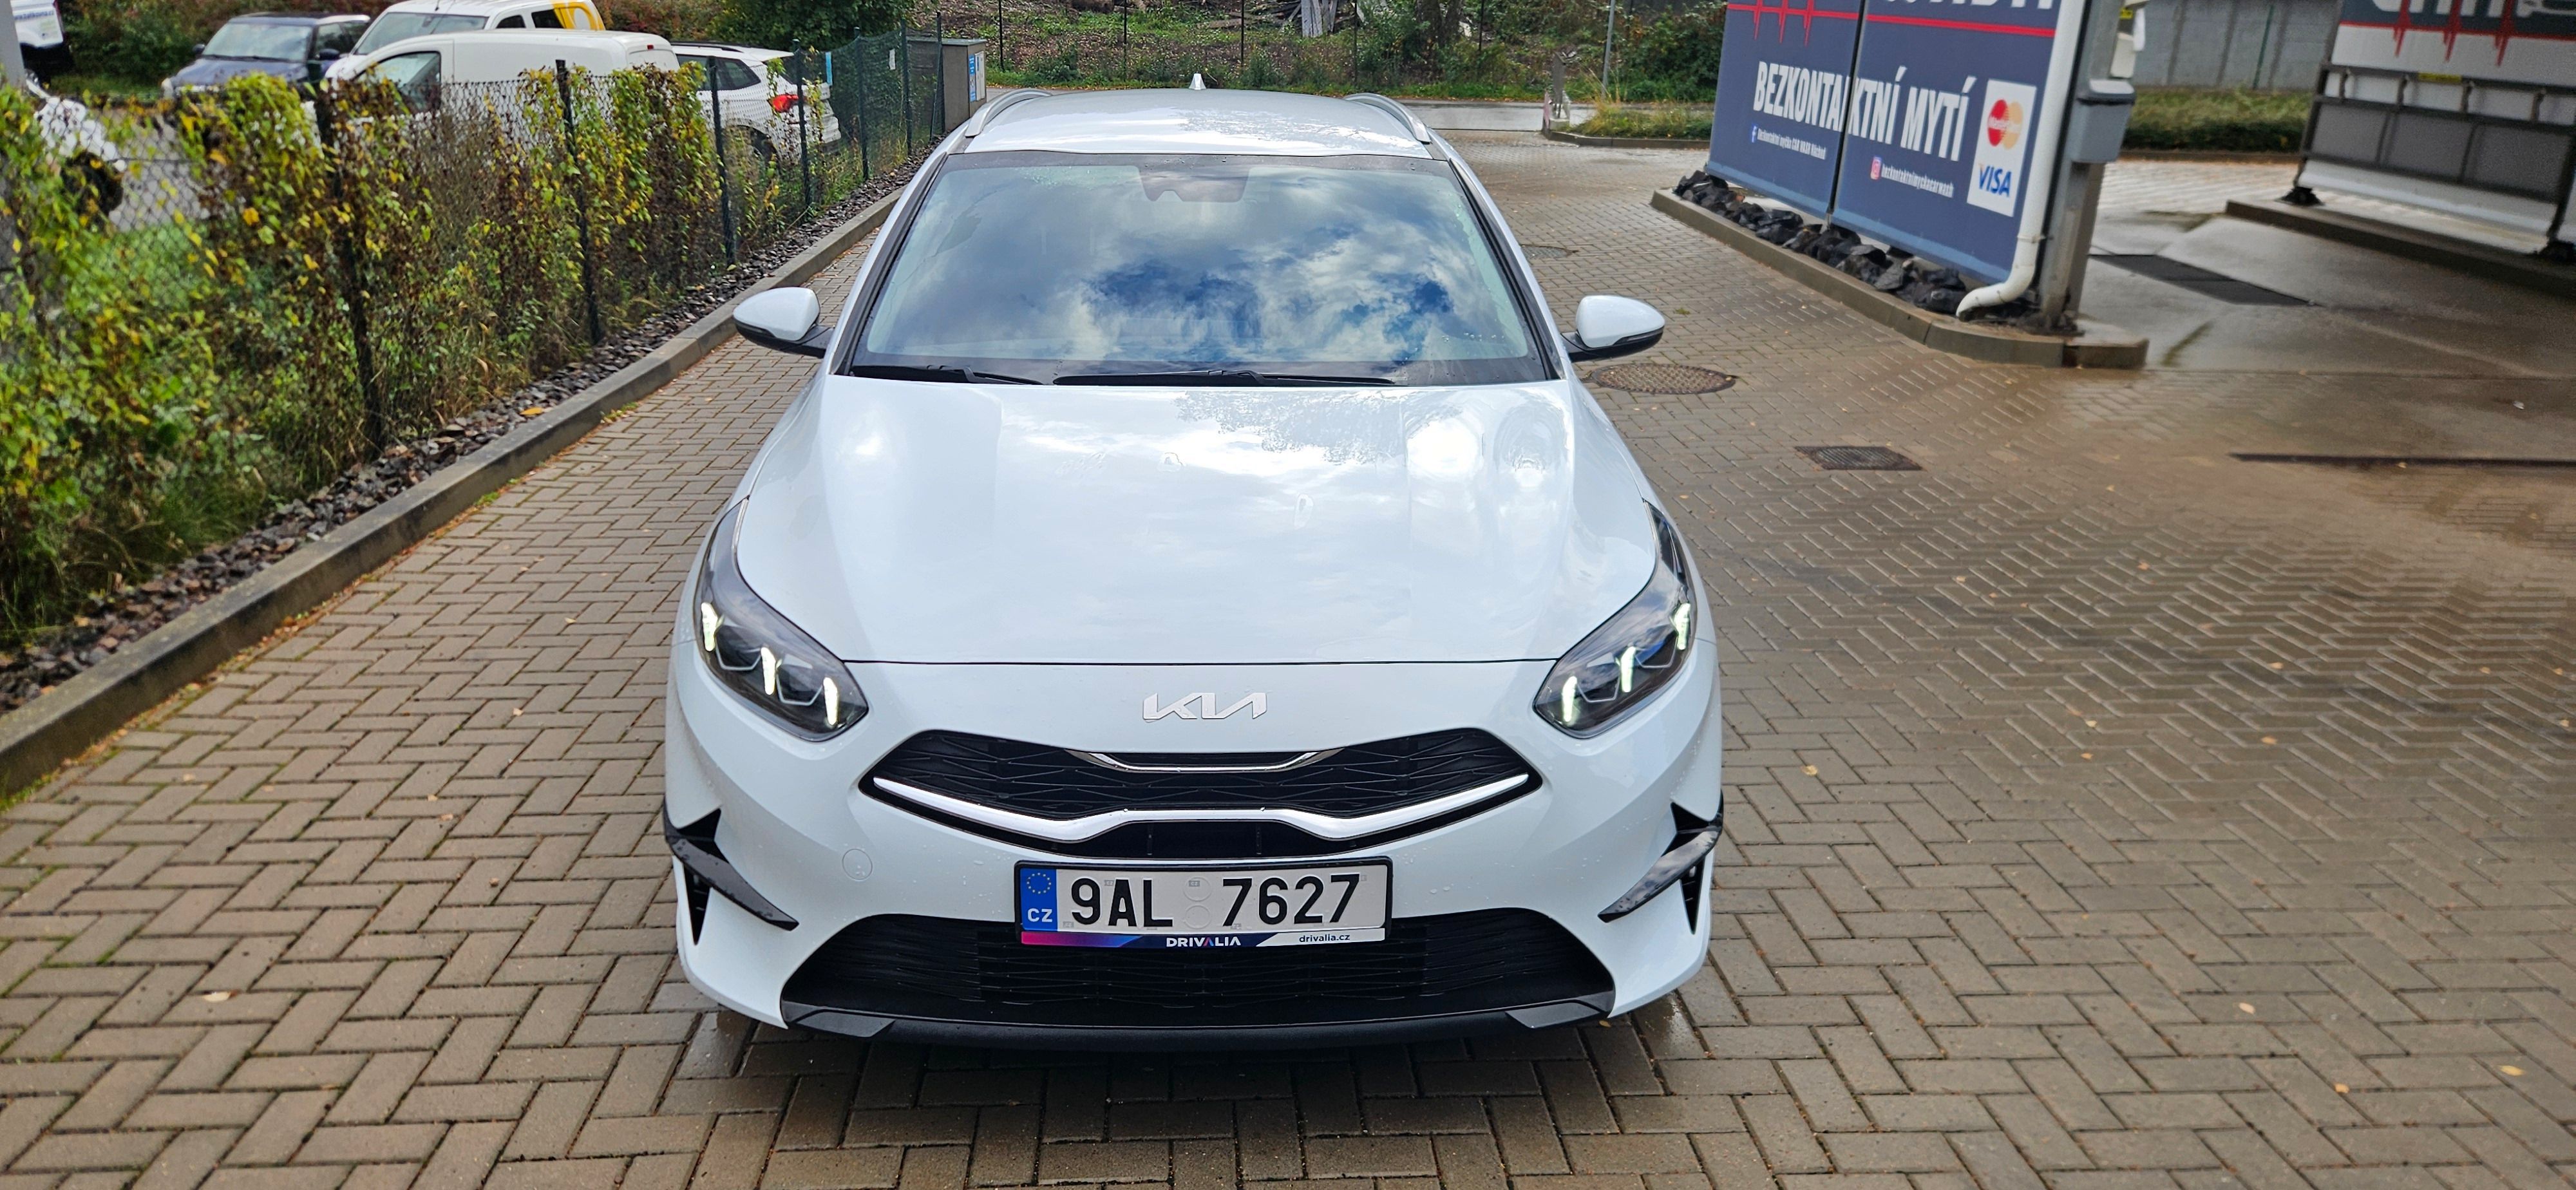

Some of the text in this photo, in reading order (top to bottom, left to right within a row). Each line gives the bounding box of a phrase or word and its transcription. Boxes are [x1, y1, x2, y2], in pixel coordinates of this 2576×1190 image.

[1753, 61, 1978, 162] BEZKONTAKTNÍ MYTÍ
[1978, 163, 2012, 198] VISA
[1143, 692, 1267, 720] KIA
[1071, 873, 1361, 927] 9AL 7627
[1027, 908, 1053, 923] CZ
[1166, 936, 1242, 948] DRIVALIA
[1298, 933, 1350, 943] drivalia.cz
